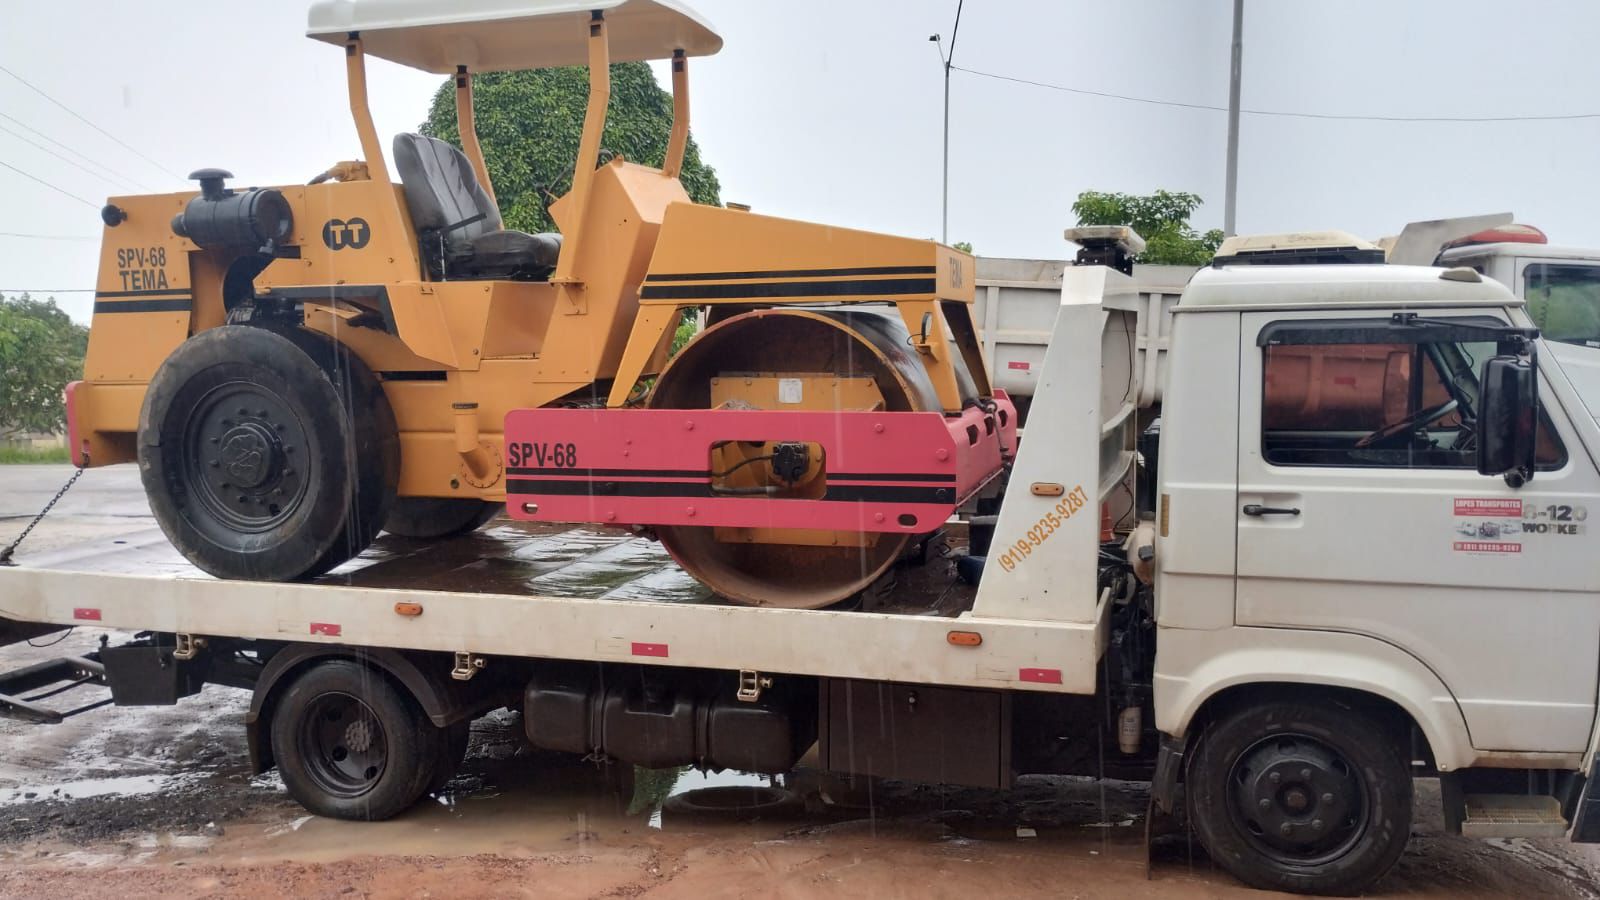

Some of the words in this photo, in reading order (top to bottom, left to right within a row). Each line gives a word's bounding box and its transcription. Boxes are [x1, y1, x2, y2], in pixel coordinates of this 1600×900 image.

[117, 246, 167, 269] SPV-68
[119, 268, 169, 291] TEMA
[508, 441, 578, 468] SPV-68
[1476, 500, 1521, 509] TRANSPORTES
